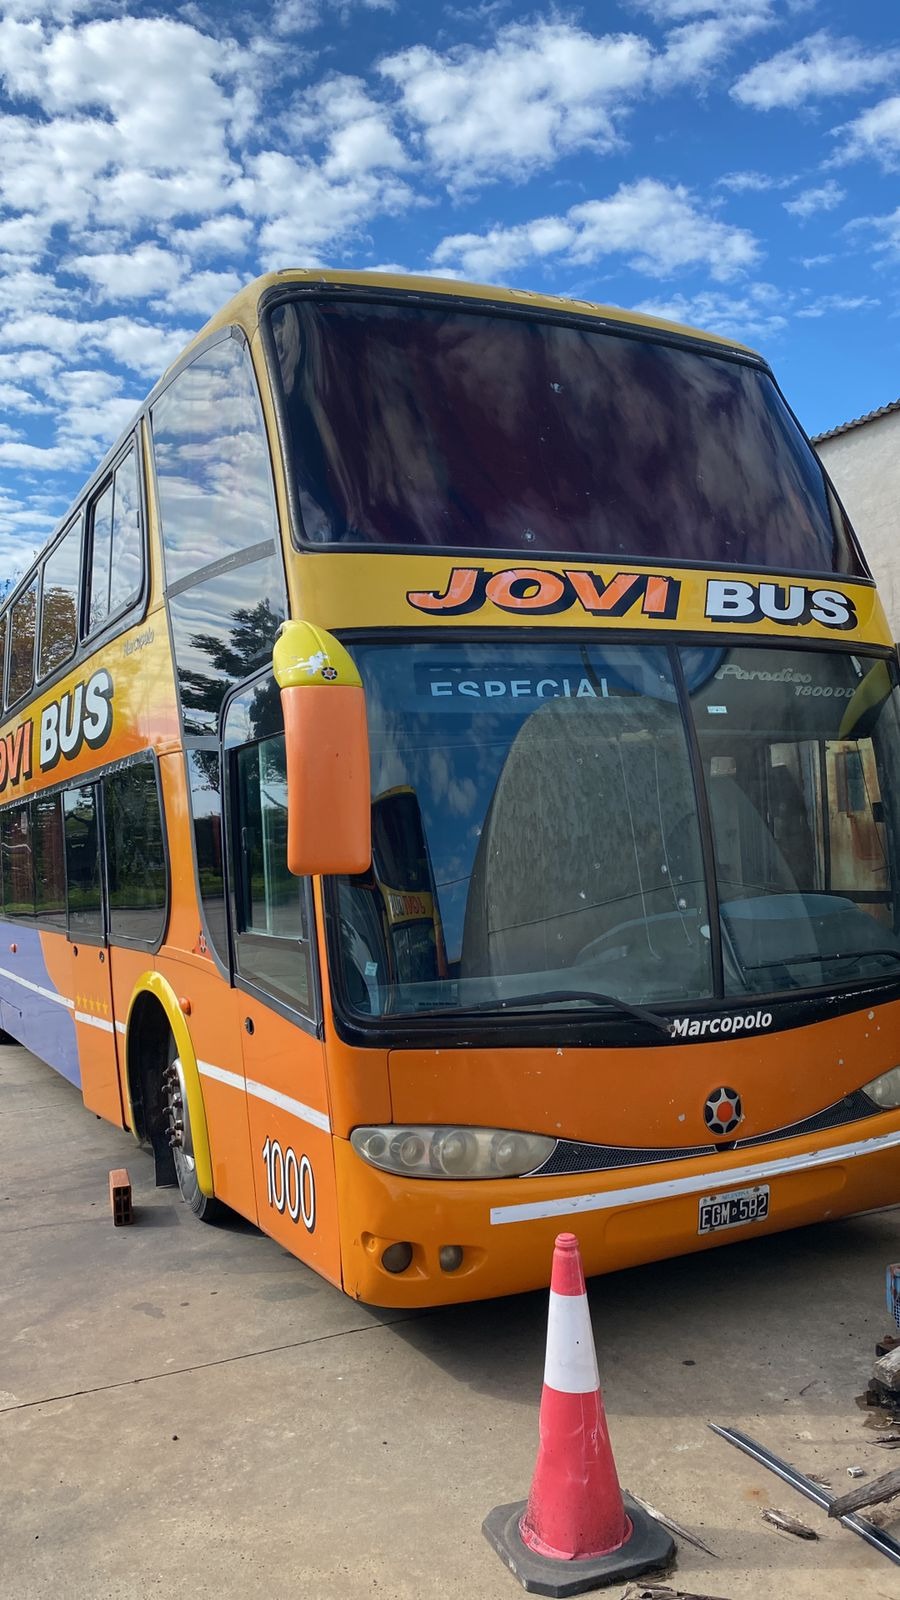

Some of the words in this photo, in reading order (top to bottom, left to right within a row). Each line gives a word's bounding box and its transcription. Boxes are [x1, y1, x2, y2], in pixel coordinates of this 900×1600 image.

[406, 567, 677, 618] JOVI
[705, 579, 856, 629] BUS
[40, 668, 114, 773] BUS
[671, 1011, 772, 1038] Marcopolo
[262, 1135, 315, 1233] 1000
[702, 1202, 730, 1228] EGM
[739, 1195, 767, 1220] 582
